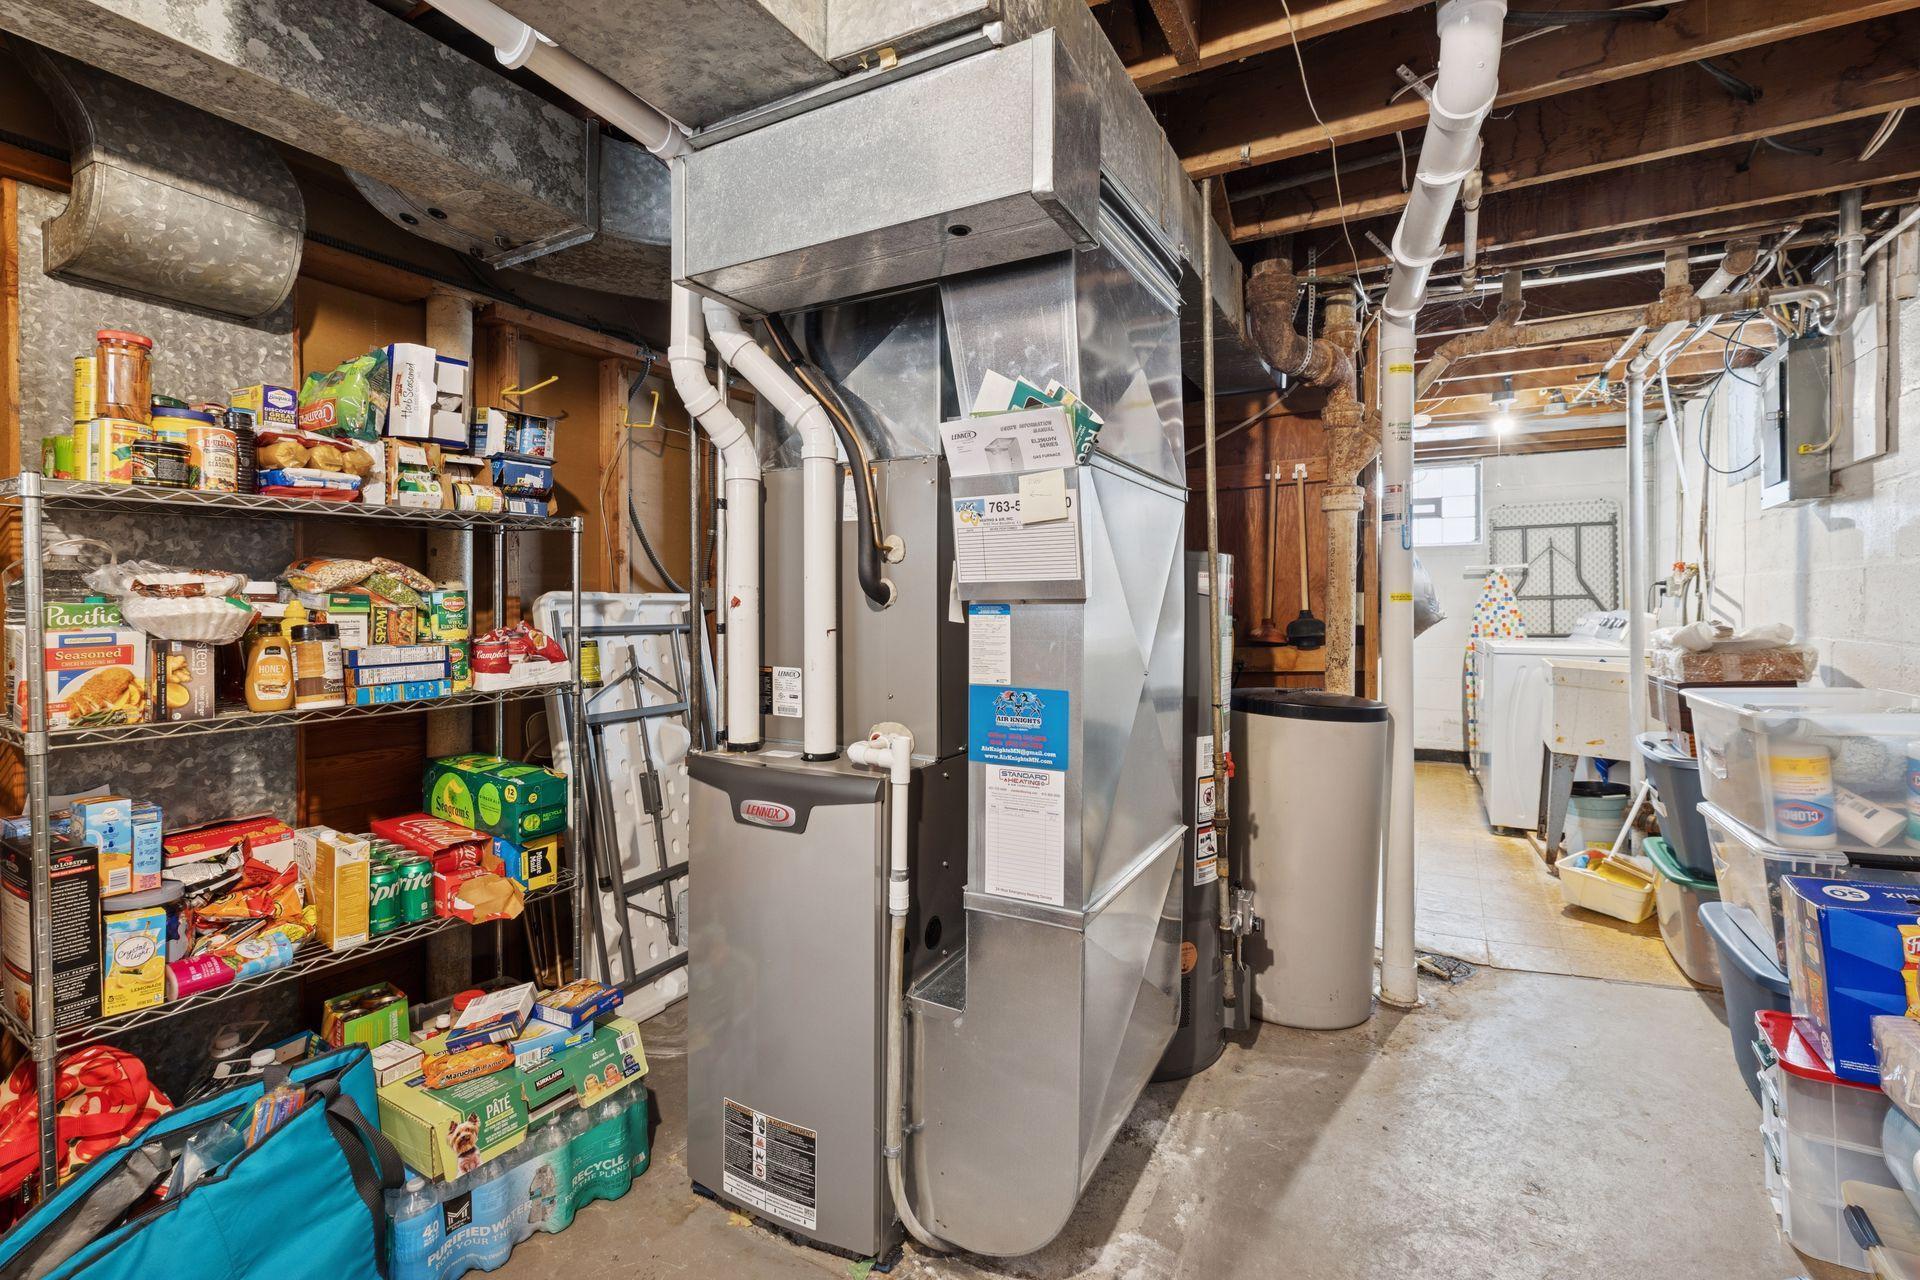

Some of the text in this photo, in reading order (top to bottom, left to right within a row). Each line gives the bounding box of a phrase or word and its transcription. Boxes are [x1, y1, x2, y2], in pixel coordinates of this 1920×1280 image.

[264, 406, 296, 414] DISCOVER
[269, 412, 295, 420] GREAT
[951, 430, 977, 441] LENNOX
[44, 605, 122, 627] Pacific
[375, 608, 387, 644] SPAM
[54, 647, 122, 661] Seasoned
[196, 641, 208, 676] steep
[259, 664, 287, 675] HONEY
[777, 669, 800, 679] LENNOX
[1010, 716, 1041, 725] KNIGHTS
[1001, 770, 1048, 781] STANDARD
[1007, 778, 1041, 787] HEATING
[507, 787, 515, 796] 12
[435, 795, 470, 821] Seagram's
[746, 803, 783, 821] LENNOX
[535, 850, 543, 875] Minute
[117, 941, 148, 960] Crystal
[130, 982, 162, 993] LEMONADE
[446, 1058, 506, 1081] Maruchan Ramen
[536, 1068, 564, 1087] KIRKLAND
[486, 1092, 513, 1120] PÂTÉ
[571, 1153, 624, 1188] RECYCLE
[599, 1160, 630, 1178] PLANET
[422, 1219, 440, 1238] 40
[427, 1200, 532, 1267] PURIFIED WATER
[455, 1237, 489, 1250] YOUR
